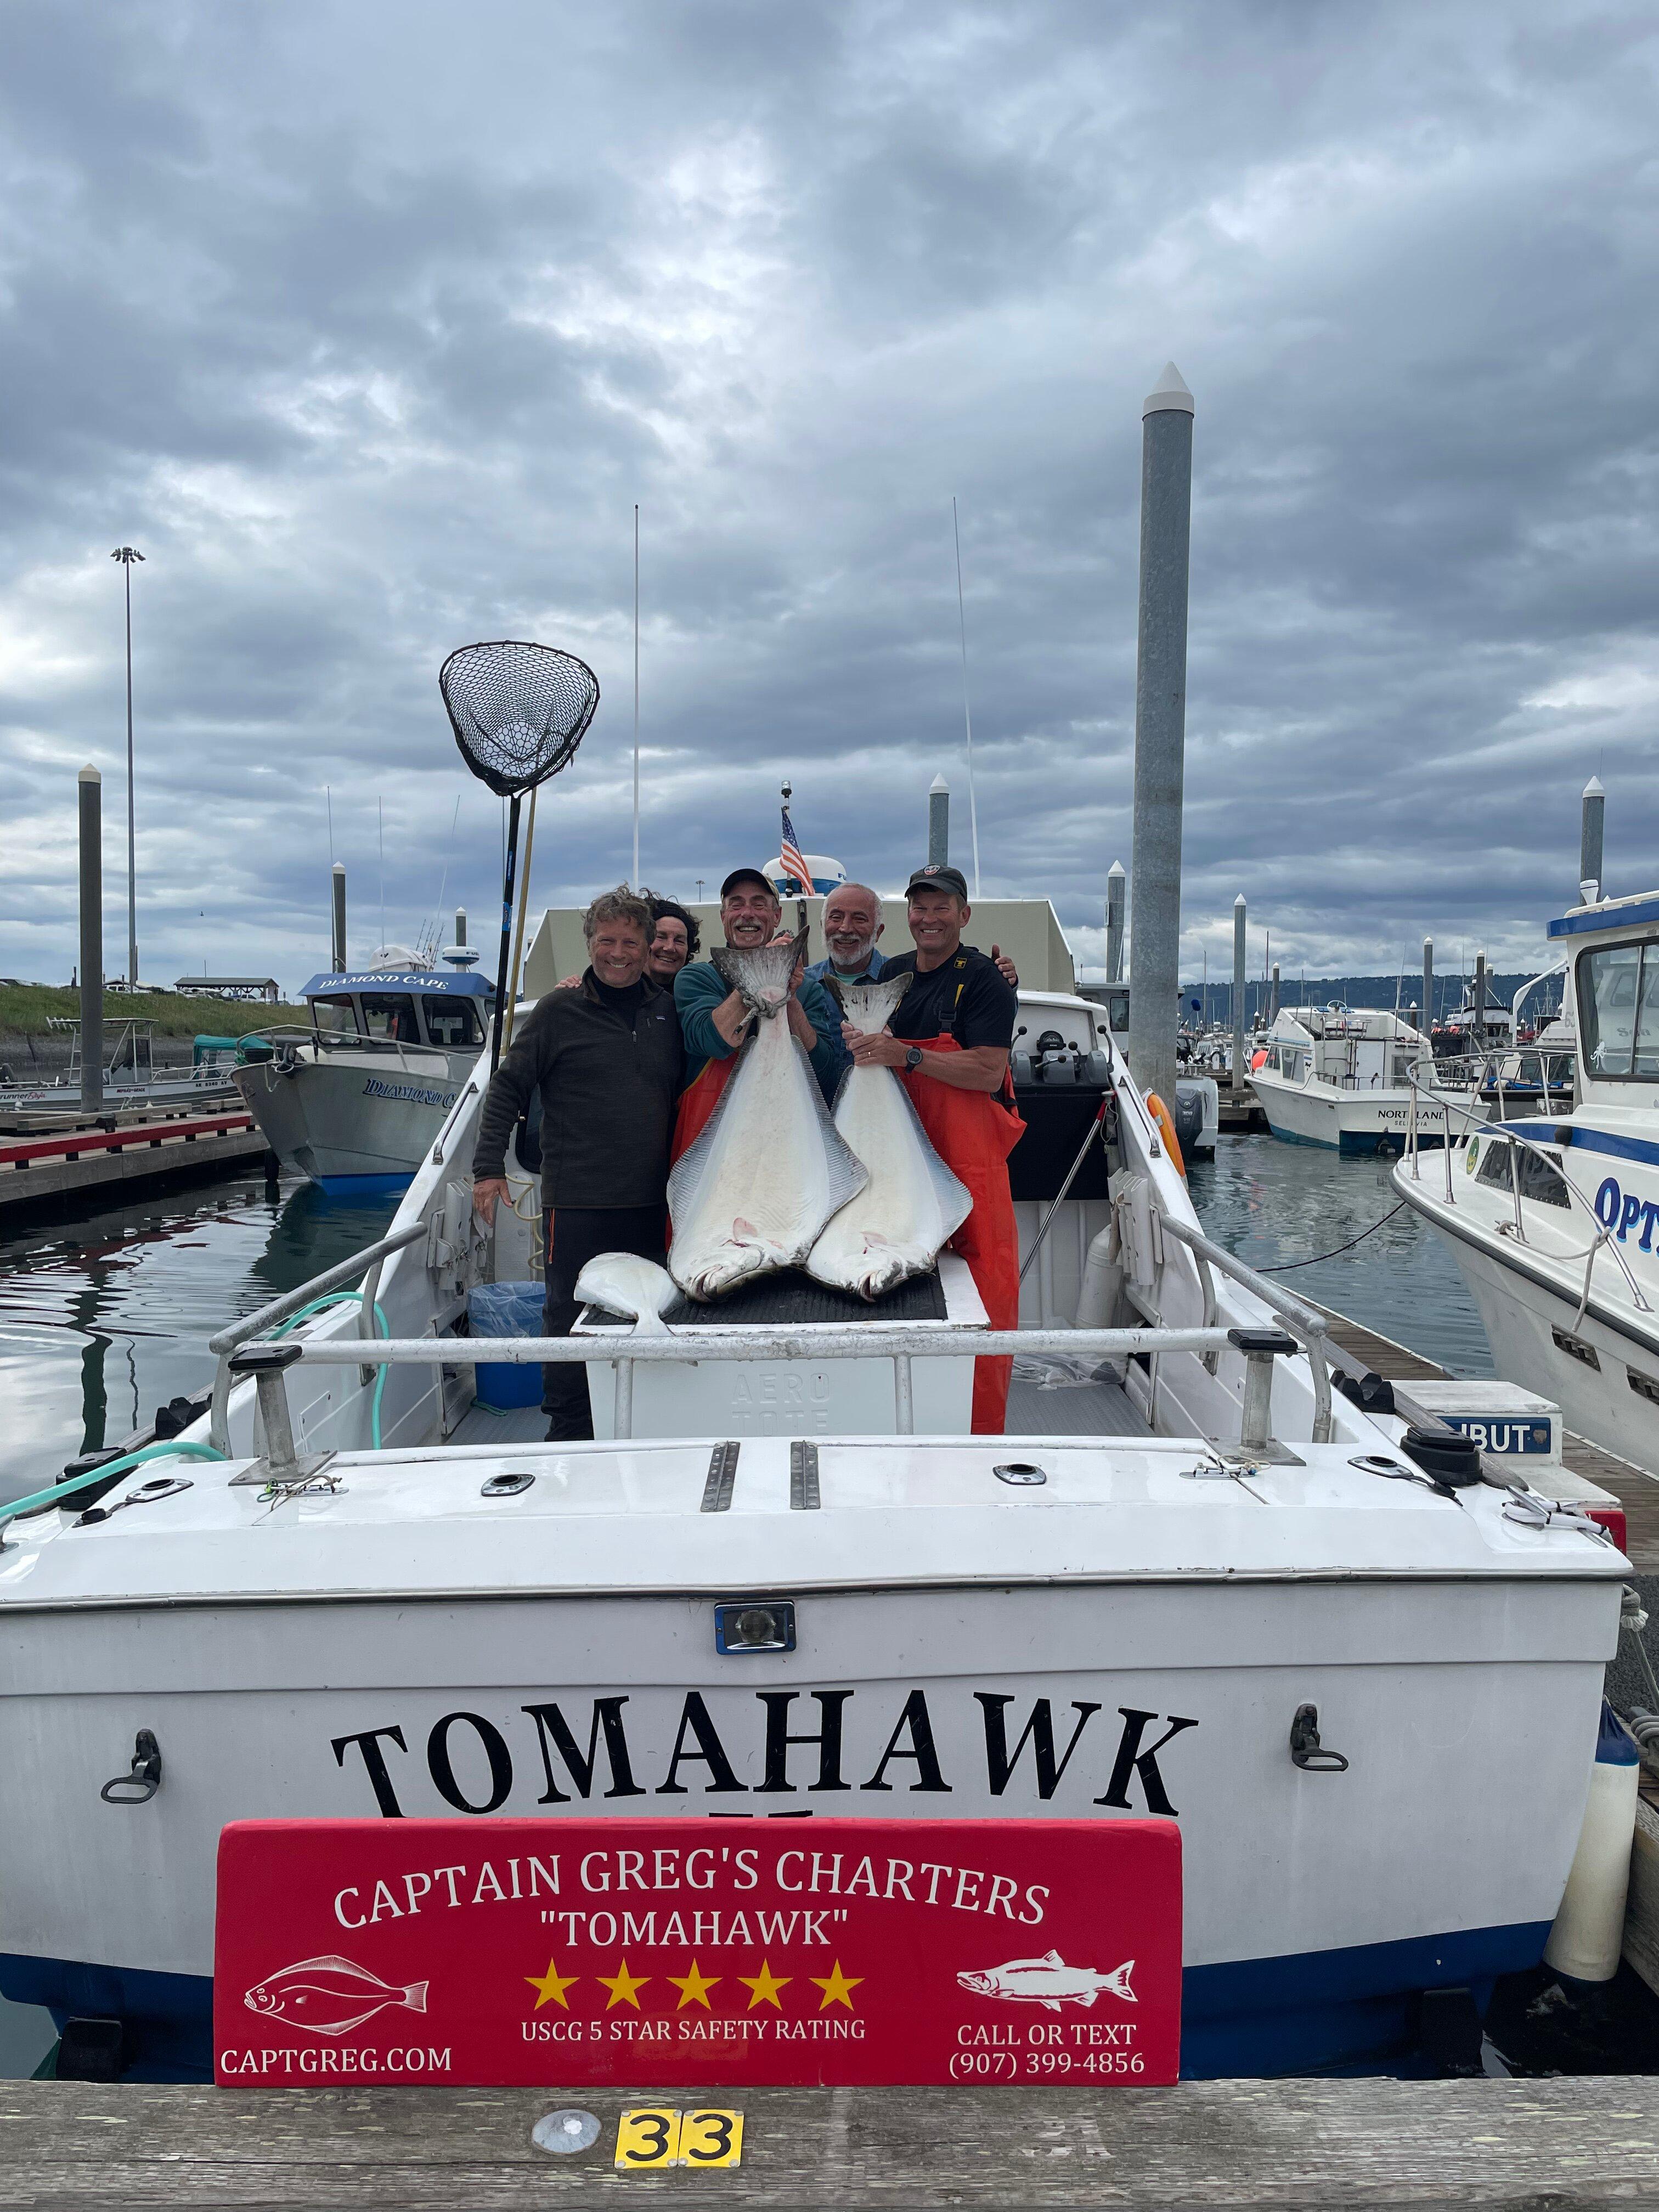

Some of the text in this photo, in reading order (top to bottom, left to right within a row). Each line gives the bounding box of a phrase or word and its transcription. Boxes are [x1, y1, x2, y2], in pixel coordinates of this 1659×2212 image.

[318, 975, 449, 990] DIAMOND CAPE
[363, 1078, 443, 1105] DIAMOND
[1378, 1110, 1444, 1120] NORTLAND
[1594, 1177, 1659, 1257] OPT
[732, 1372, 830, 1404] AERO
[732, 1409, 829, 1436] TOTE
[330, 1690, 1199, 1818] TOMAHAWK
[334, 1847, 1051, 1929] CAPTAIN GREG'S CHARTERS
[540, 1909, 848, 1946] "TOMAHAWK"
[521, 2019, 866, 2041] USCG 5 STAR SAFETY RATING
[957, 2024, 1137, 2046] CALL OR TEXT
[220, 2047, 452, 2074] CAPTGREG.COM
[949, 2052, 1145, 2079] (907) 399-4856
[625, 2114, 733, 2162] 33
